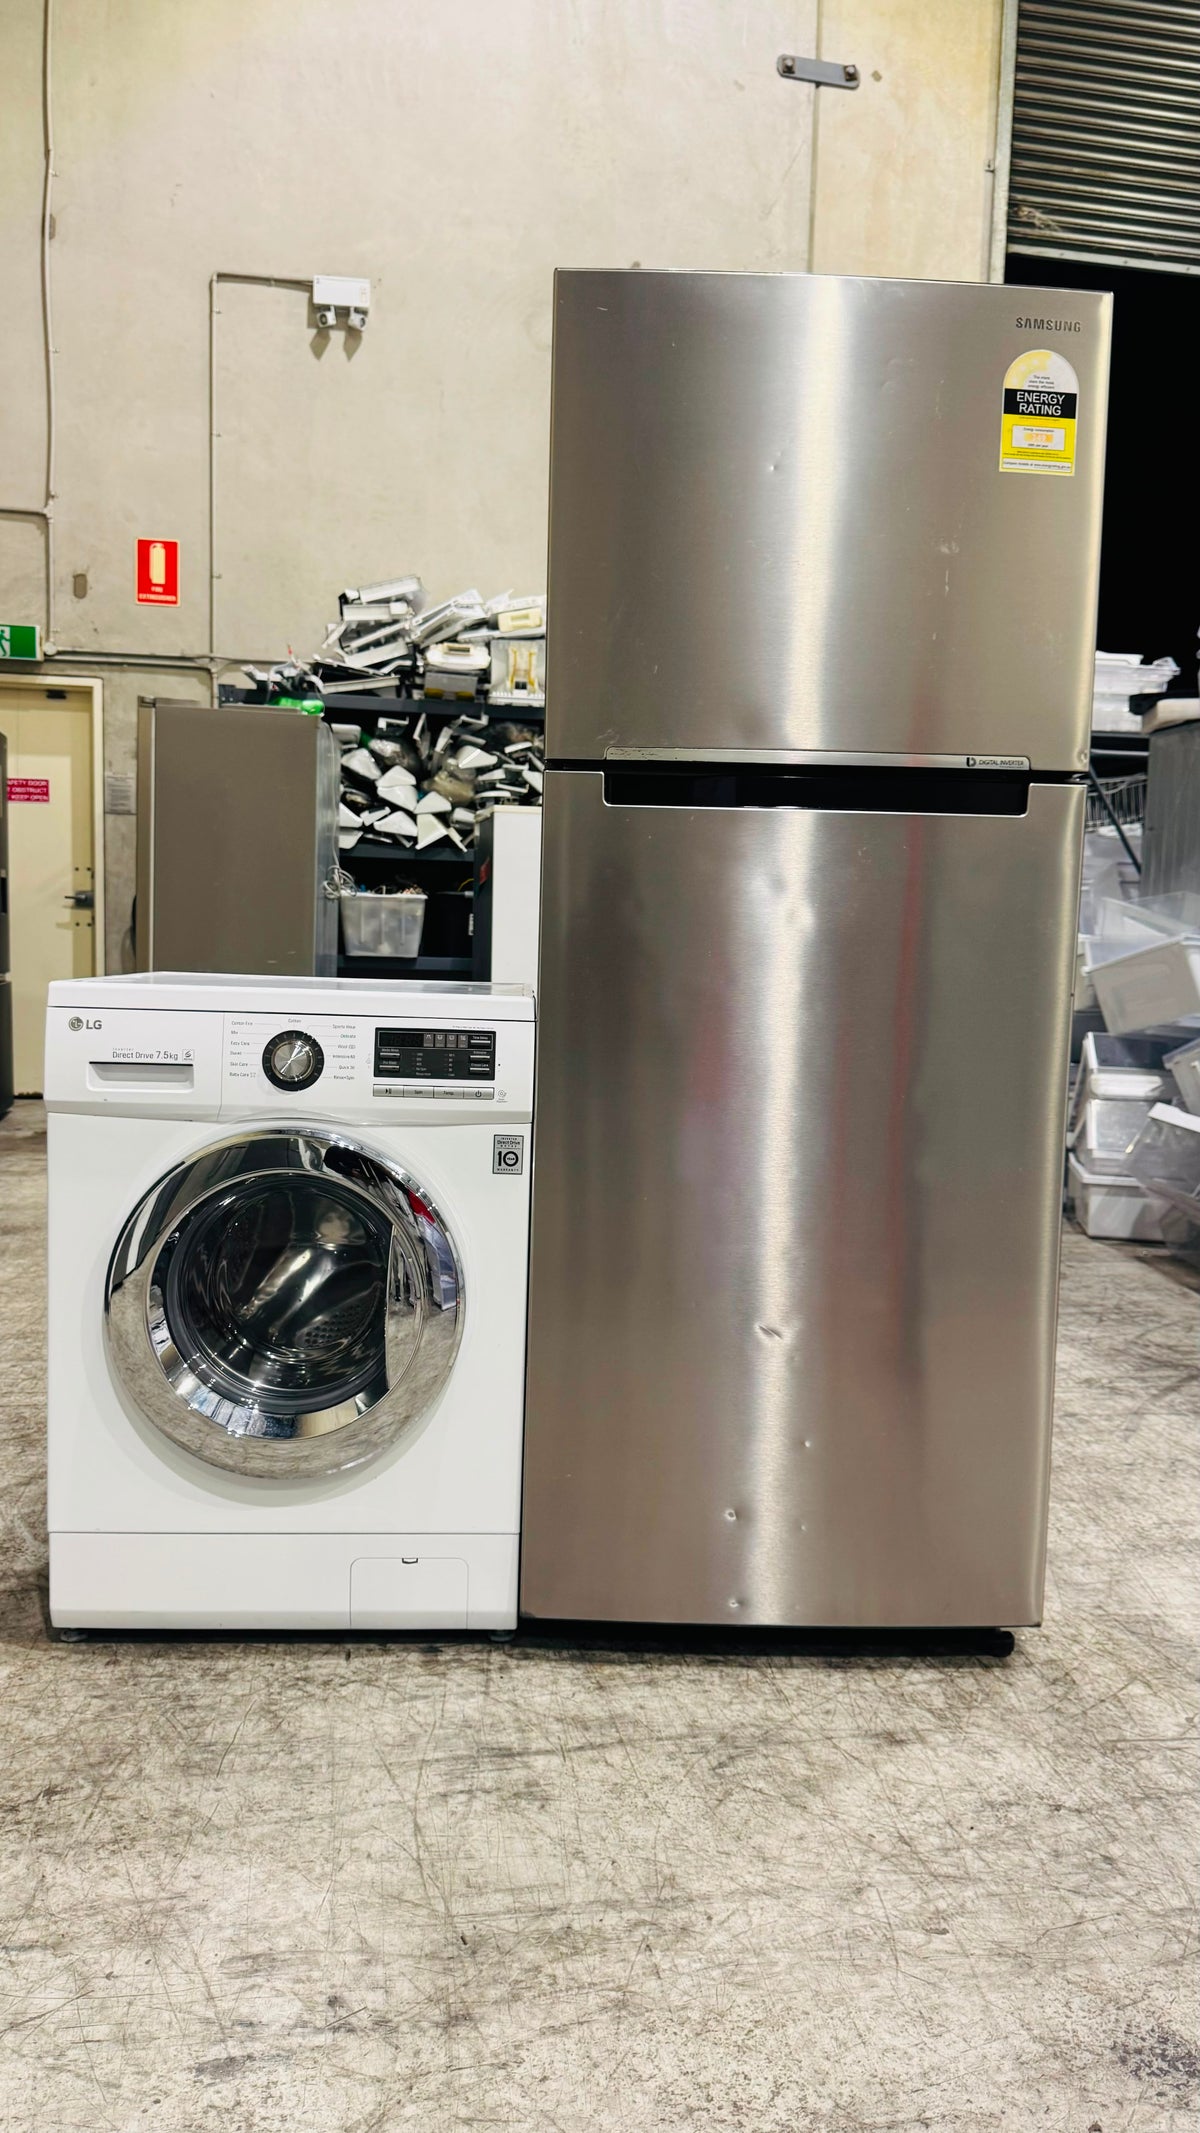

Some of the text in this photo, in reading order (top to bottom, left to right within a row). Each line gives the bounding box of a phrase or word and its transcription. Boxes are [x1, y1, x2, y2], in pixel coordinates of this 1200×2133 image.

[1016, 317, 1081, 333] SAMSUNG
[1016, 391, 1066, 405] ENERGY
[1018, 403, 1062, 416] RATING
[86, 1019, 103, 1030] LG
[112, 1051, 134, 1059] Direct
[135, 1052, 154, 1060] Drive
[155, 1051, 179, 1061] 7.5kg
[497, 1150, 519, 1167] 10
